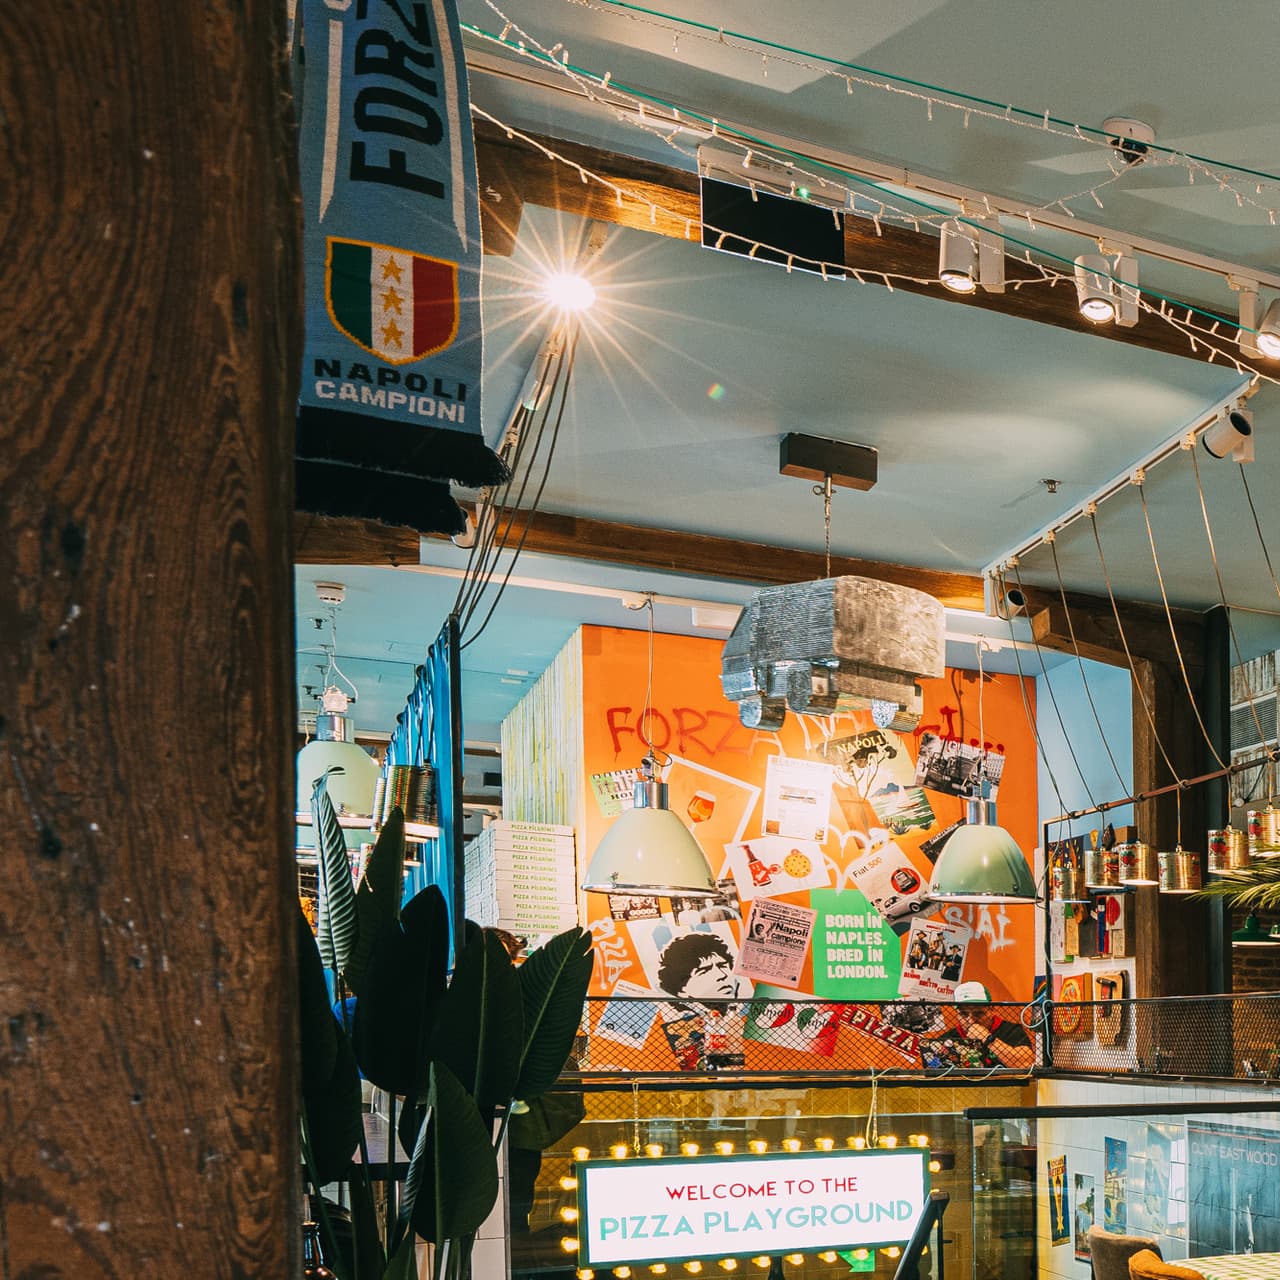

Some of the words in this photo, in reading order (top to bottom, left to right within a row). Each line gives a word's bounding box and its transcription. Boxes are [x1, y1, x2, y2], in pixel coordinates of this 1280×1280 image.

[314, 359, 467, 401] NAPOLI
[315, 380, 465, 423] CAMPIONI
[836, 734, 888, 755] NAPOLI
[852, 865, 869, 878] Fiat
[868, 856, 882, 868] 500
[775, 923, 809, 937] Napoli
[825, 914, 864, 929] BORN
[826, 931, 887, 945] NAPLES.
[827, 948, 863, 962] BRED
[827, 964, 888, 979] LONDON.
[851, 1010, 914, 1051] PIZZA
[1219, 1146, 1279, 1167] EASTWOOD
[666, 1181, 776, 1201] WELCOME
[784, 1179, 814, 1196] TO
[822, 1177, 858, 1193] THE
[600, 1214, 694, 1241] PIZZA
[704, 1199, 913, 1234] PLAYGROUND
